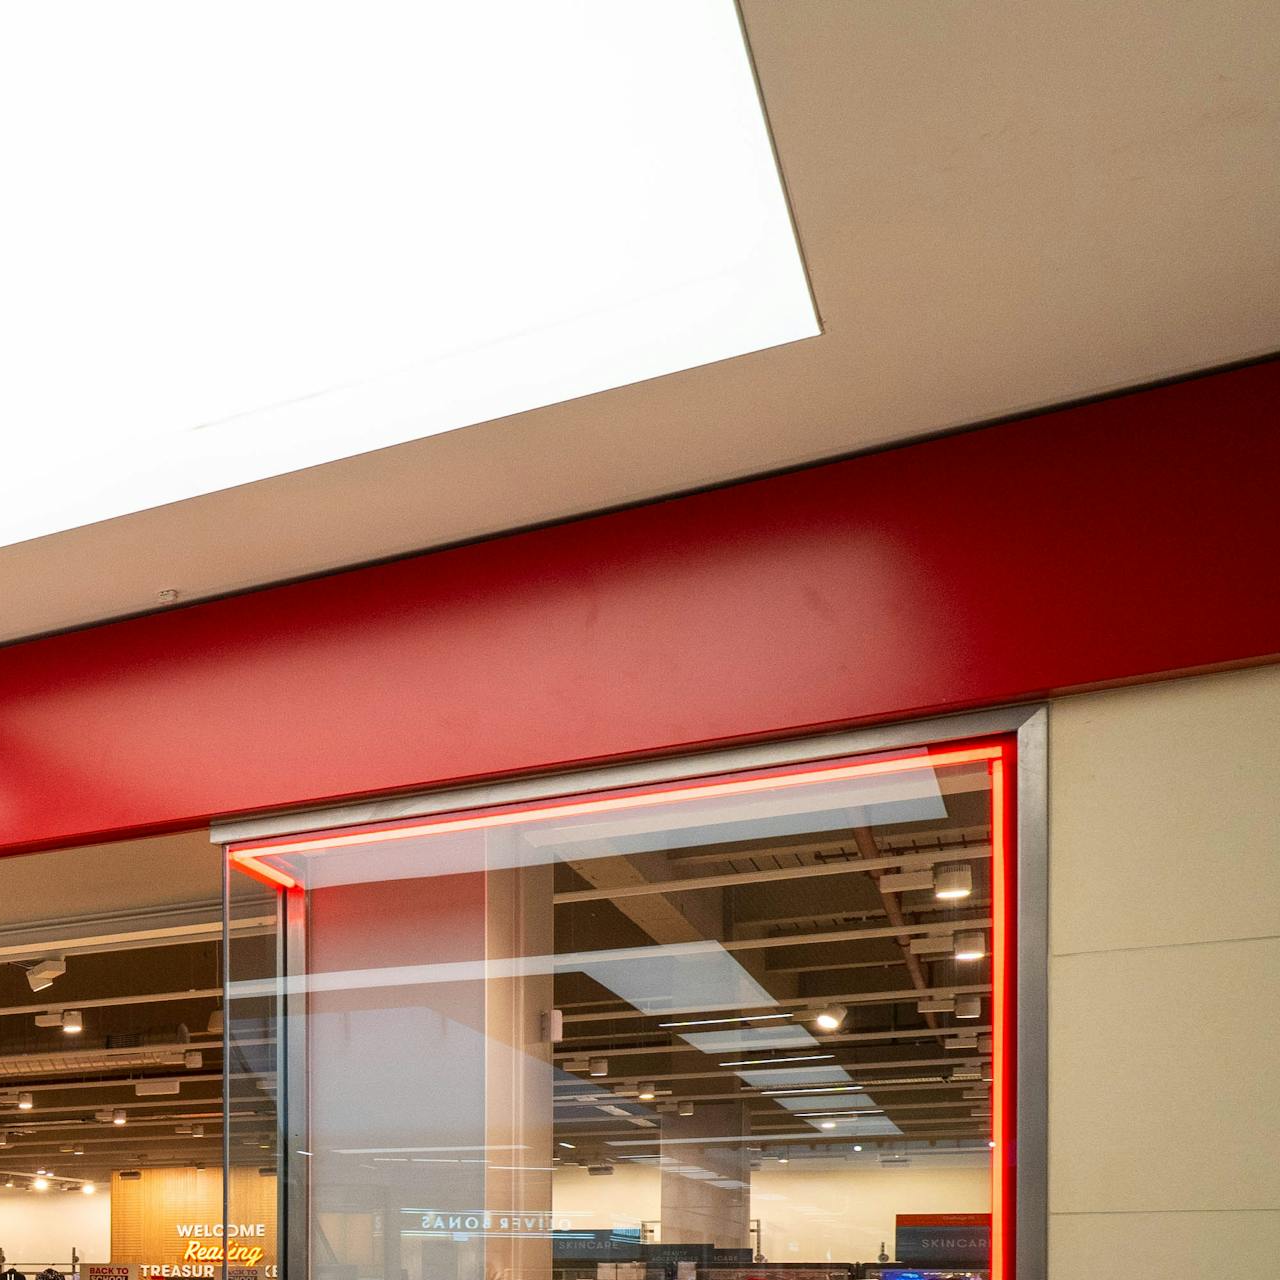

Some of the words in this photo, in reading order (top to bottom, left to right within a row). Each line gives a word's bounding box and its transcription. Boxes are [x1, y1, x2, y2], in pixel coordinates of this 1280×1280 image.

[558, 1241, 619, 1250] SKINCARE
[921, 1239, 987, 1249] SKINCAR
[89, 1267, 114, 1275] BACK
[116, 1267, 129, 1275] TO
